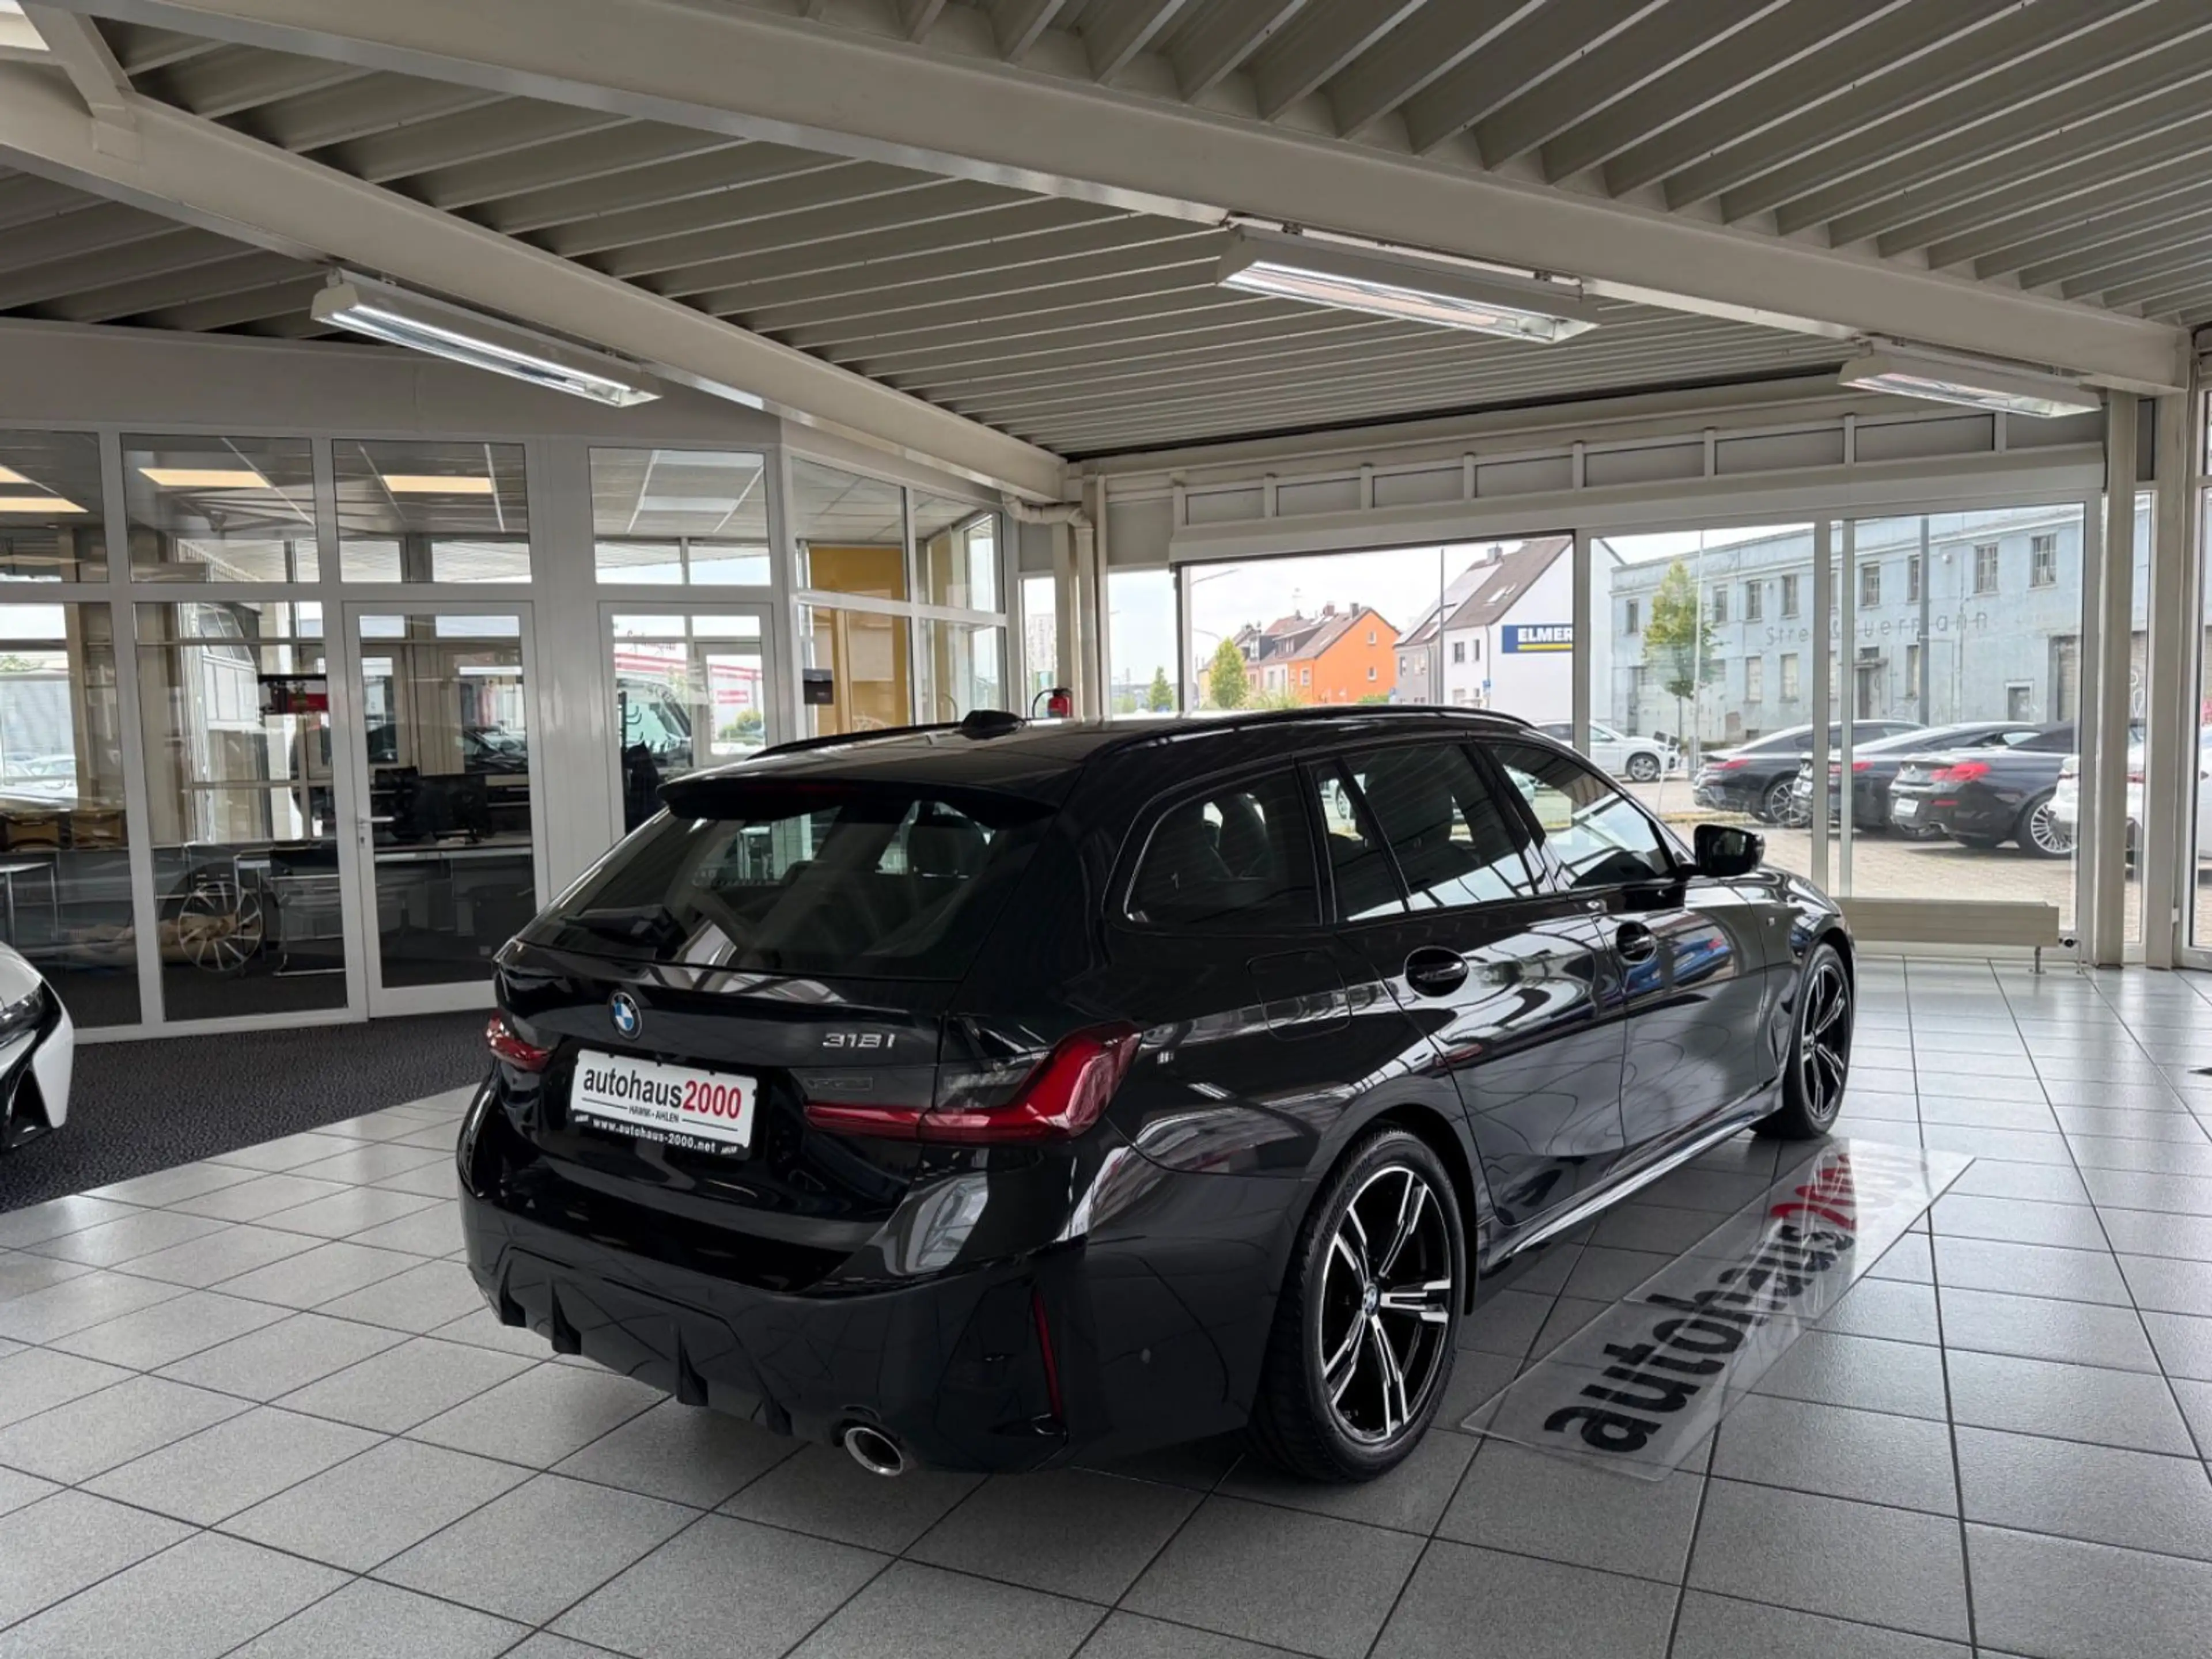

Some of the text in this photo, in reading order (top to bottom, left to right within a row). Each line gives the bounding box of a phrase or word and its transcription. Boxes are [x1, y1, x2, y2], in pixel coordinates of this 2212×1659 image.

[1517, 627, 1573, 642] ELMER
[583, 1067, 742, 1119] autohaus2000
[592, 1118, 716, 1153] www.autohaus-2000.net
